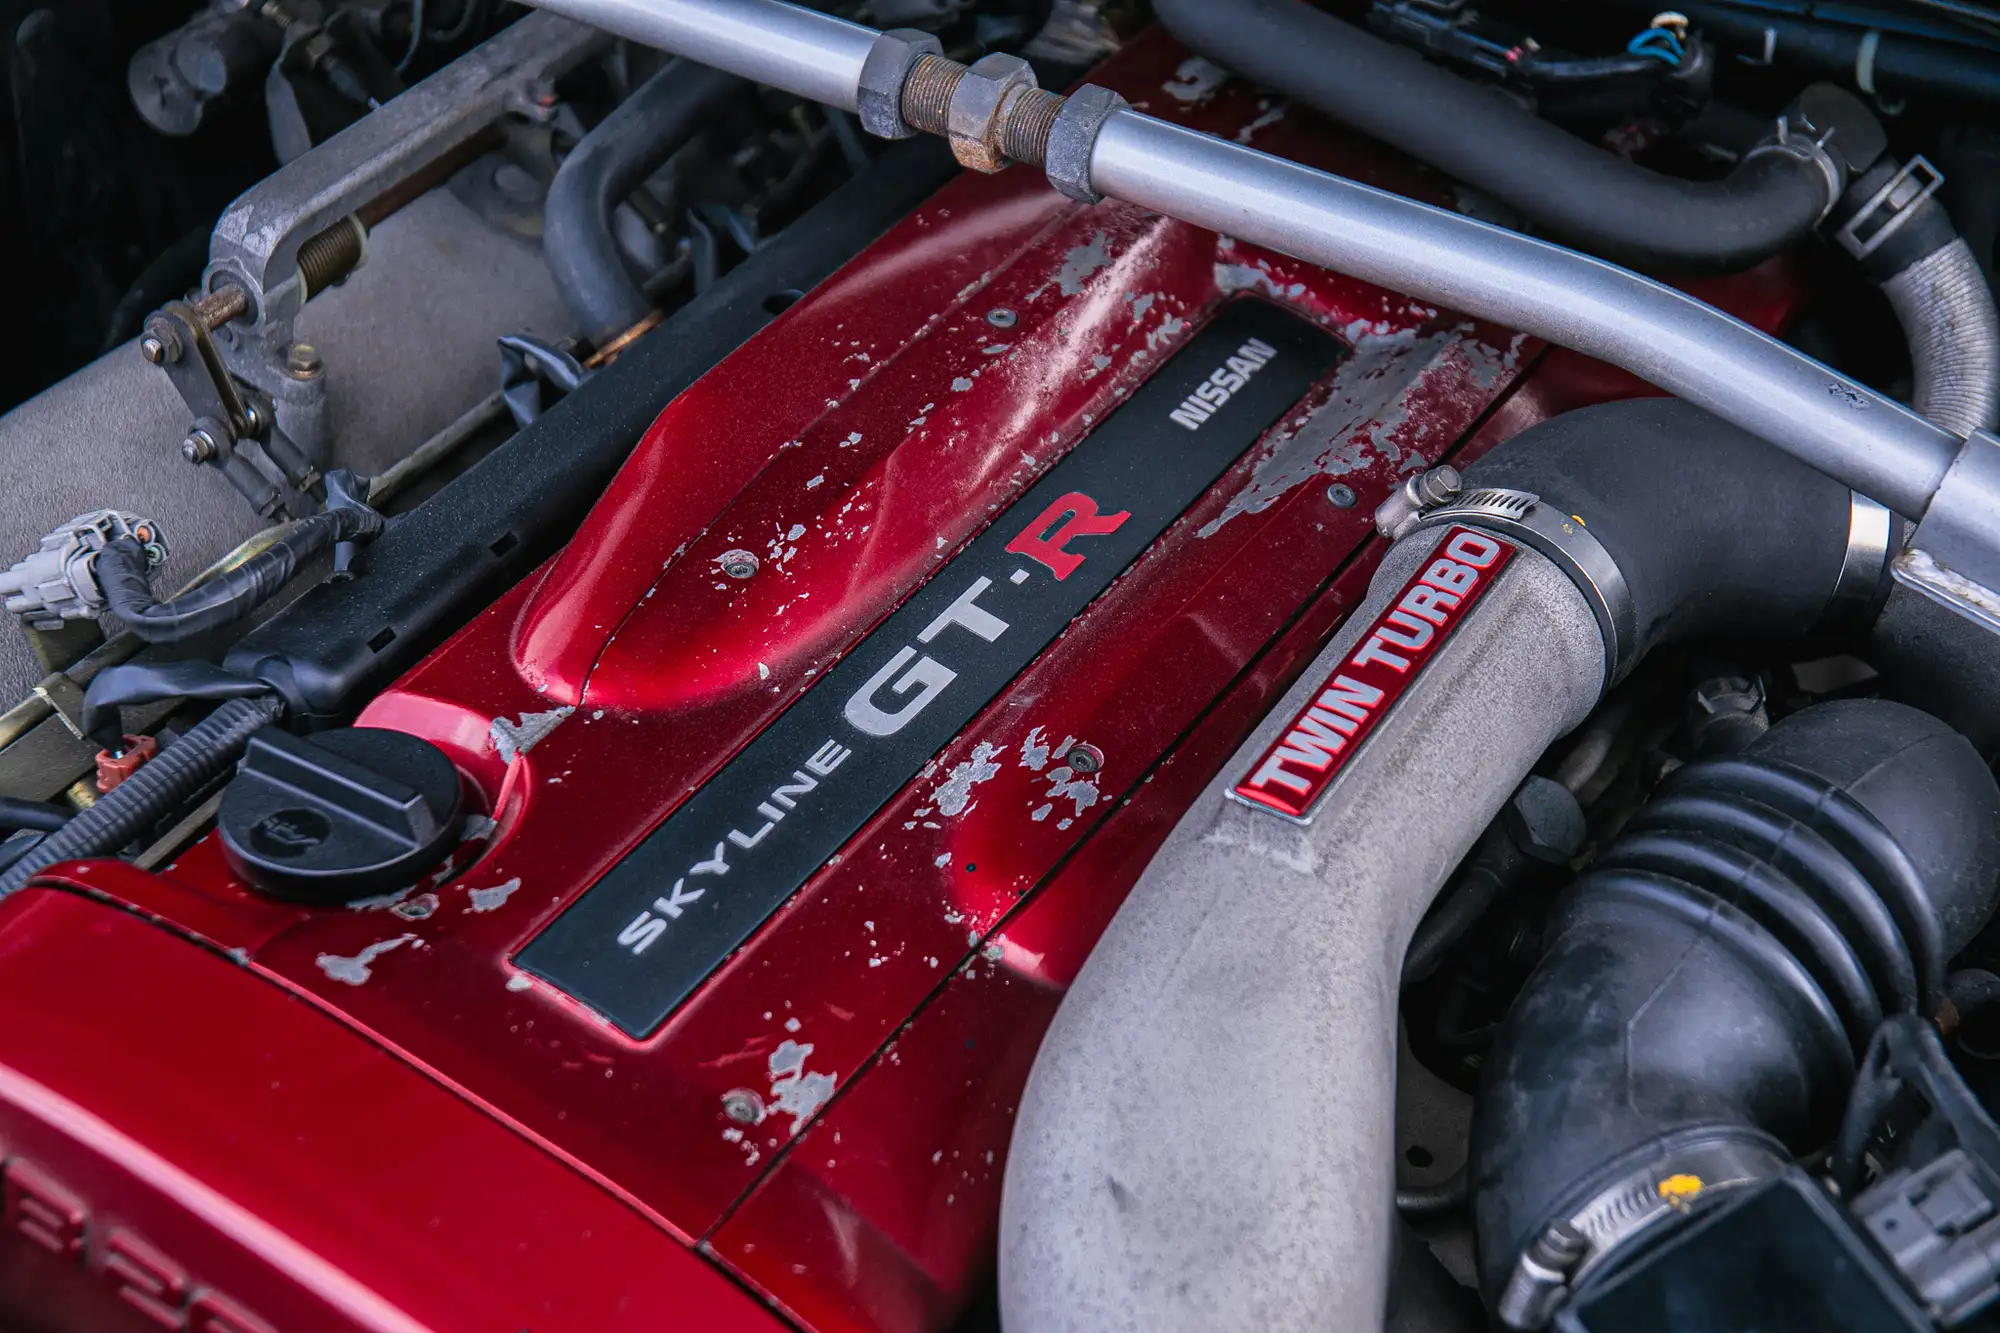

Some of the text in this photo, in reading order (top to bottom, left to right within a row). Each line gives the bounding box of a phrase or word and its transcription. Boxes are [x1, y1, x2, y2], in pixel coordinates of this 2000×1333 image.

[1169, 337, 1278, 431] NISSAN
[1249, 532, 1500, 796] TWIN TURBO
[616, 739, 852, 955] SKYLINE
